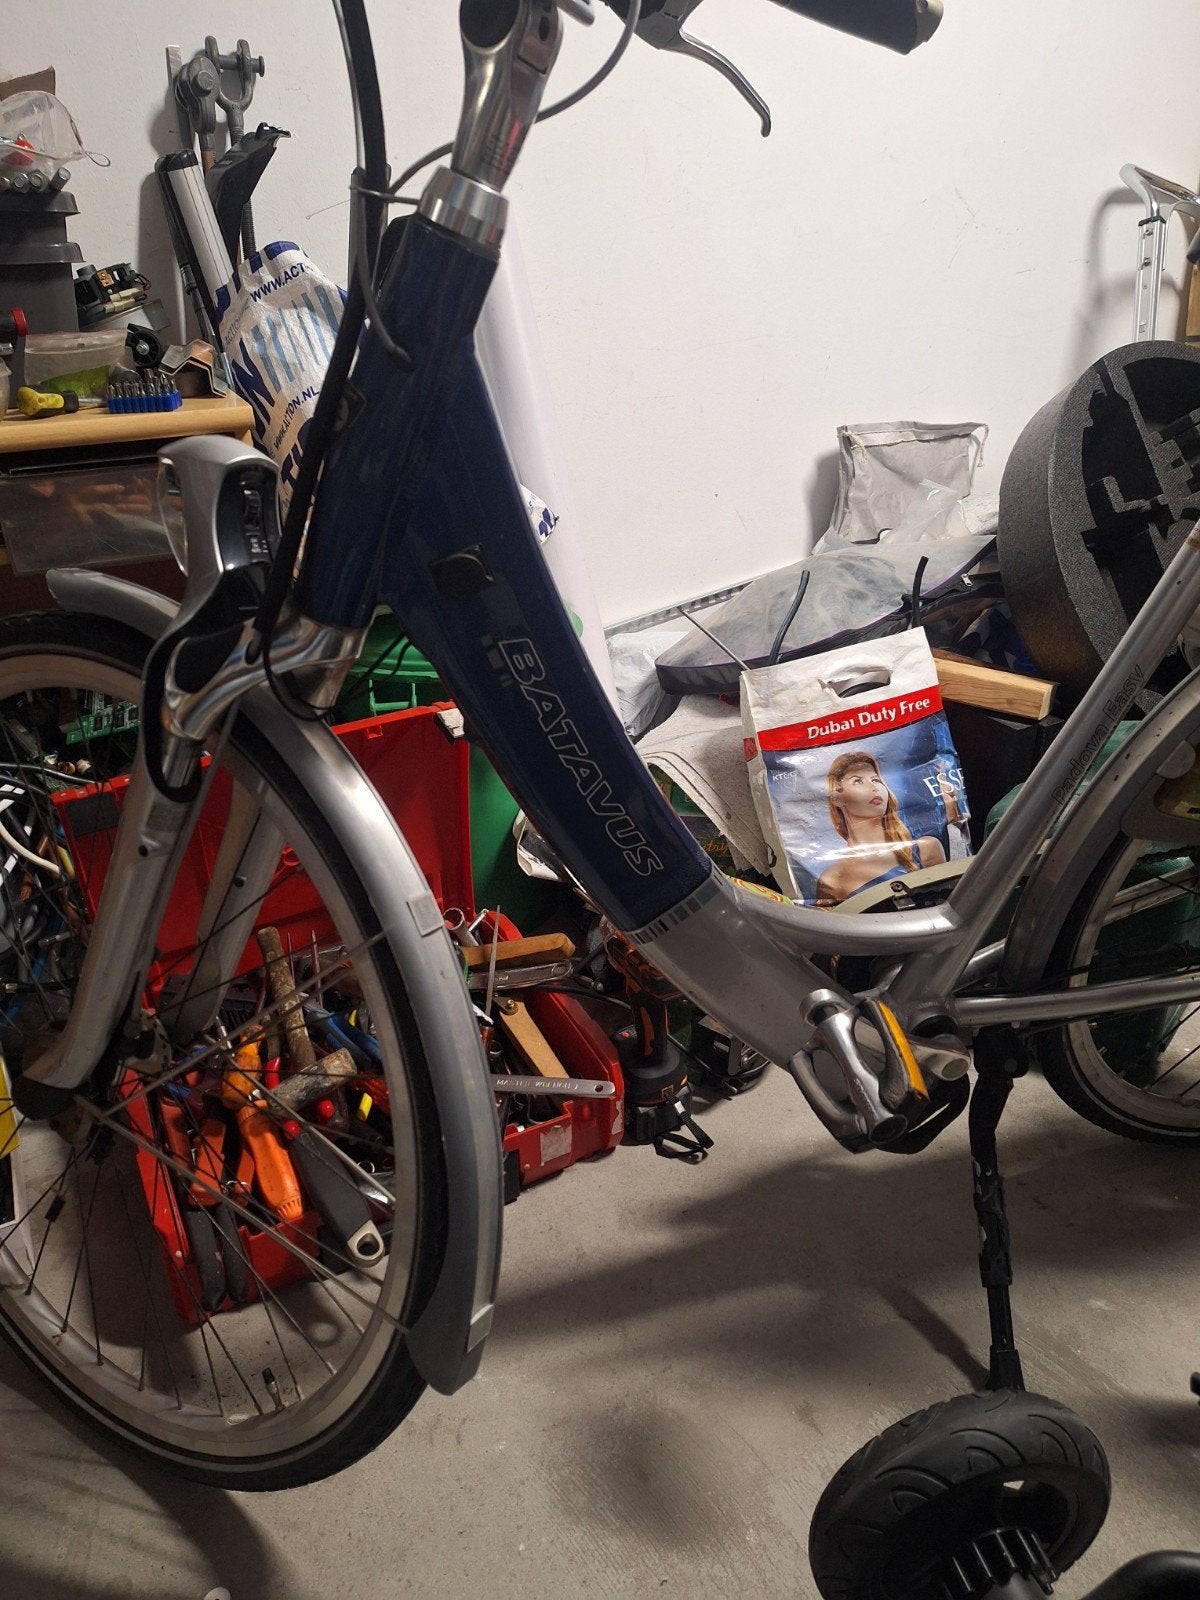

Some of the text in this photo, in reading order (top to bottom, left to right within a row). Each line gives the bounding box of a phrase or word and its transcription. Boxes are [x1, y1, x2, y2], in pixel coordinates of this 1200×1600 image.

[498, 637, 664, 877] BATAVUS
[807, 697, 931, 740] Dubai Duty Free
[1051, 663, 1145, 805] Padova Easy
